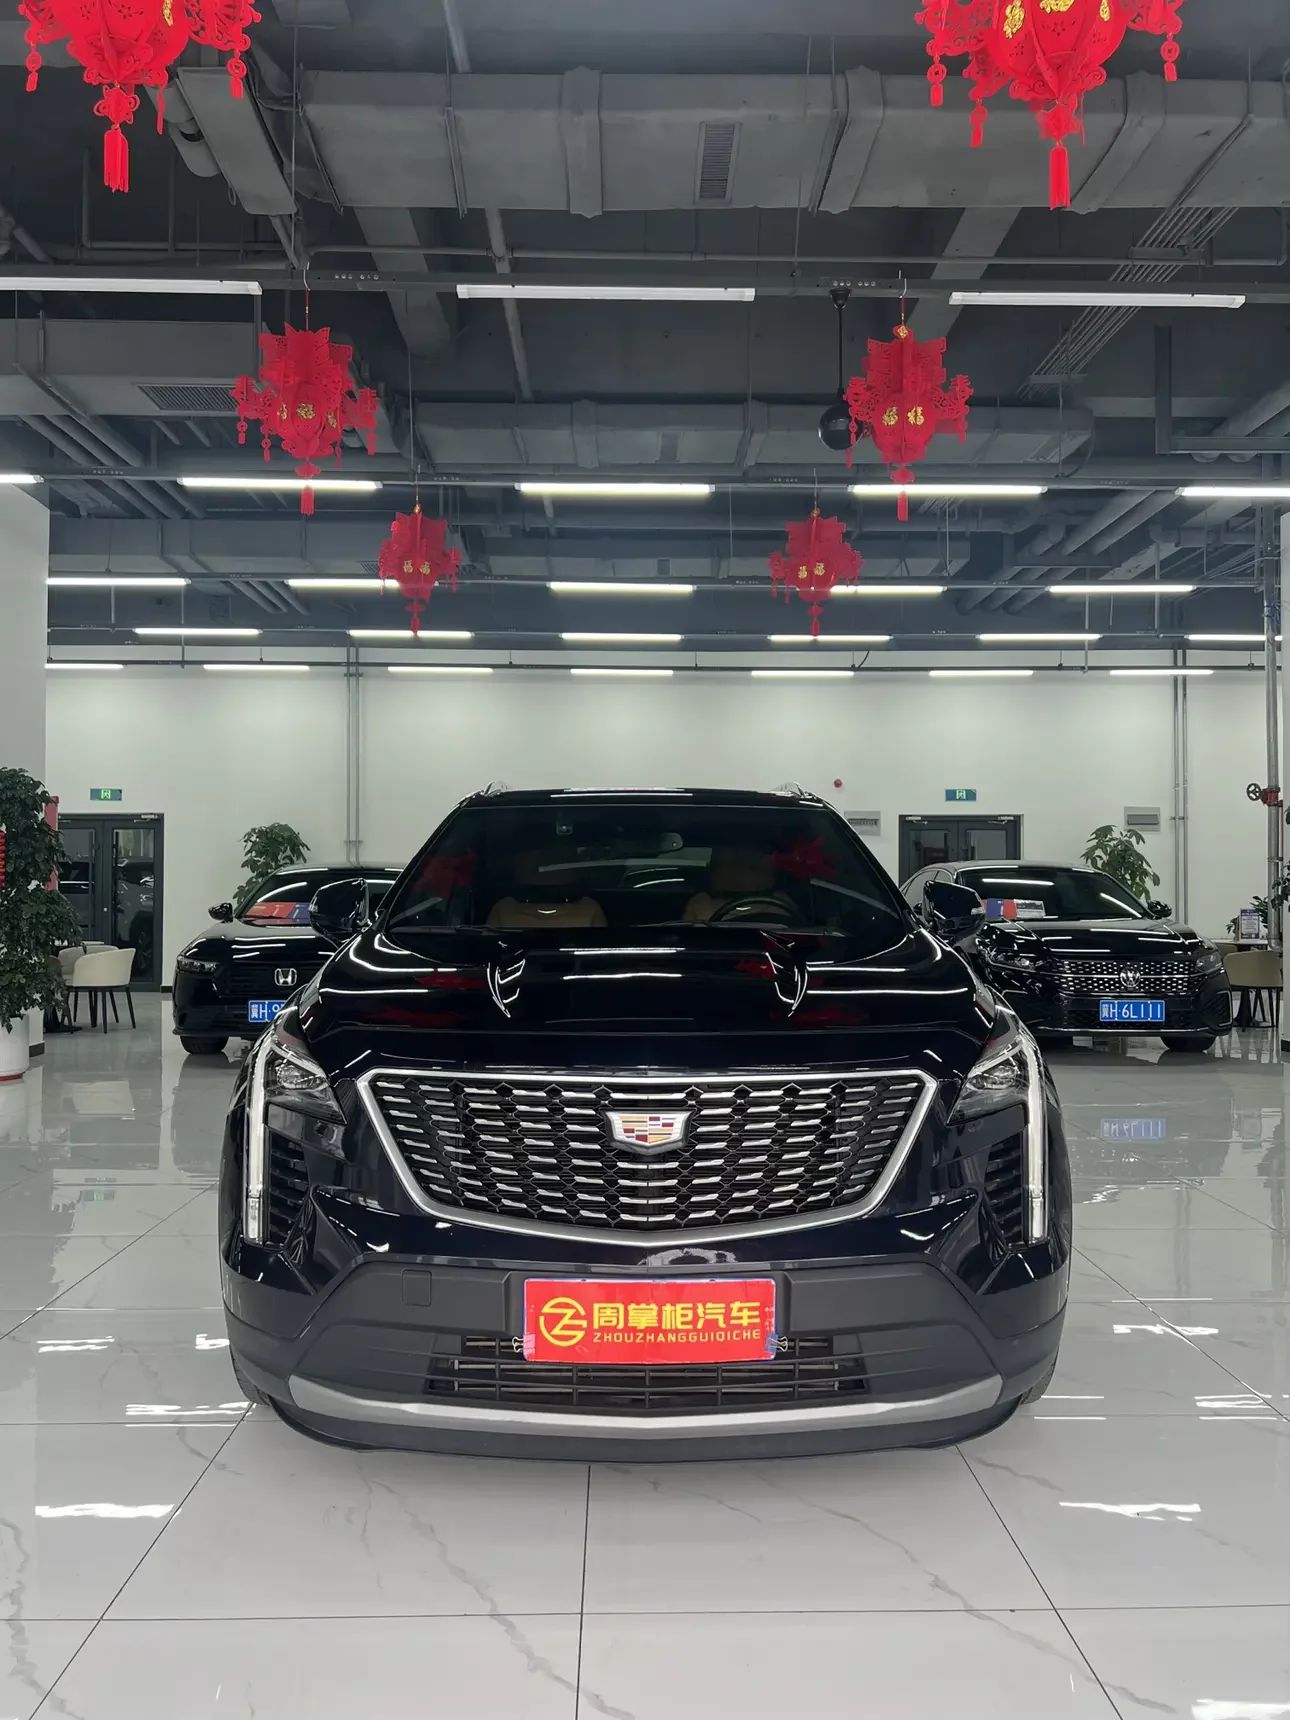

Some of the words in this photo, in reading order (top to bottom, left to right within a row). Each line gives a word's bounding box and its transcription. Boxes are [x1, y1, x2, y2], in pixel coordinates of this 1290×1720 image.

[592, 1301, 761, 1330] 周掌柜汽车
[593, 1330, 761, 1343] ZHOUZHANGGUIQICHE
